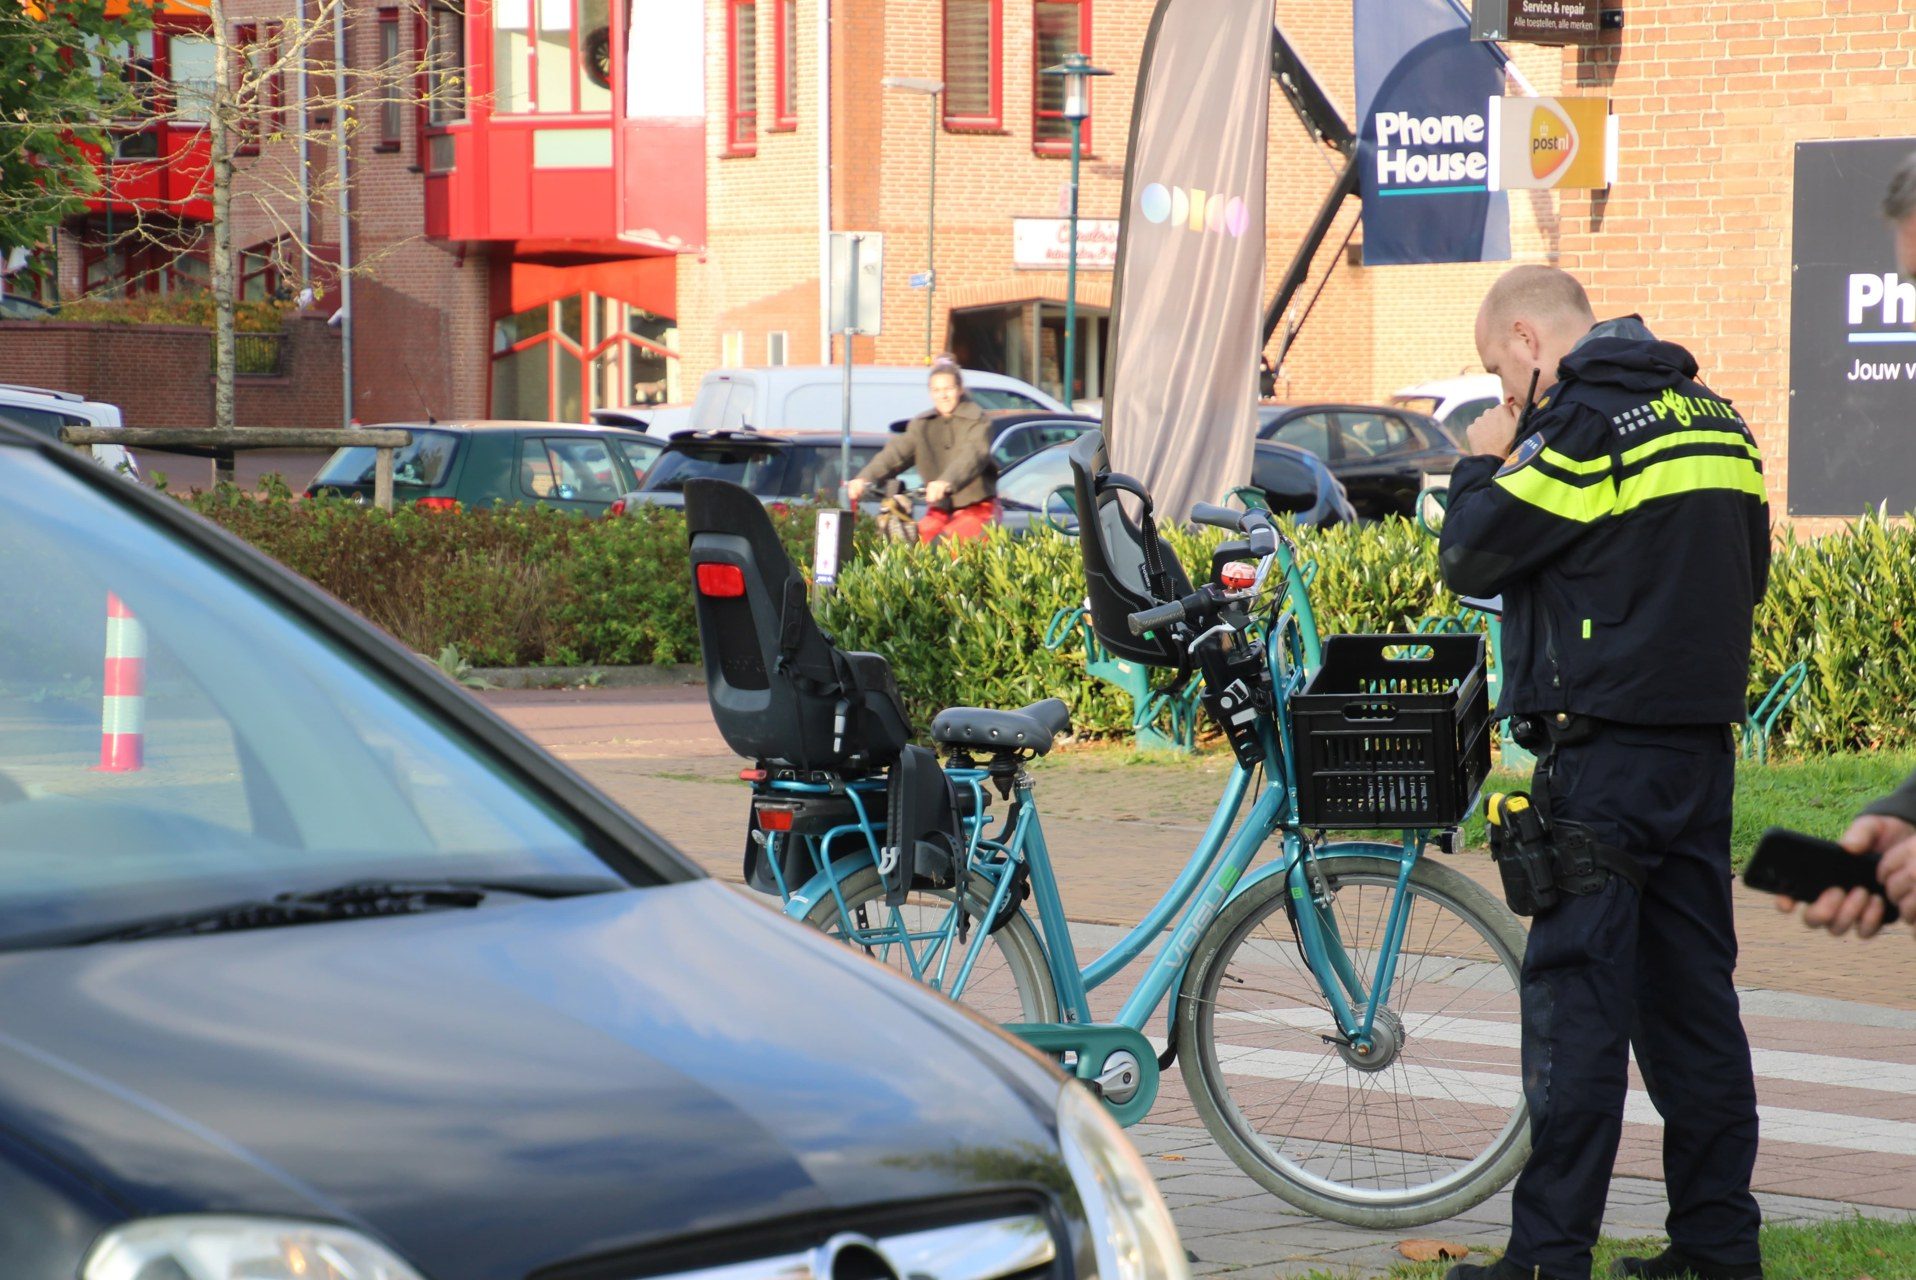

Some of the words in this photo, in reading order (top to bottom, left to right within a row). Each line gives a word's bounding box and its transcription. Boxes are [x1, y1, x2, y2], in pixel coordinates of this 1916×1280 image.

[1522, 0, 1552, 13] Service
[1553, 1, 1560, 14] &
[1561, 2, 1586, 17] repair
[1513, 16, 1526, 27] Alle
[1558, 18, 1569, 29] alle
[1375, 112, 1485, 147] Phone
[1533, 135, 1569, 155] postnl
[1377, 149, 1487, 184] House
[1847, 358, 1901, 381] Jouw
[1649, 388, 1737, 427] POLITIE
